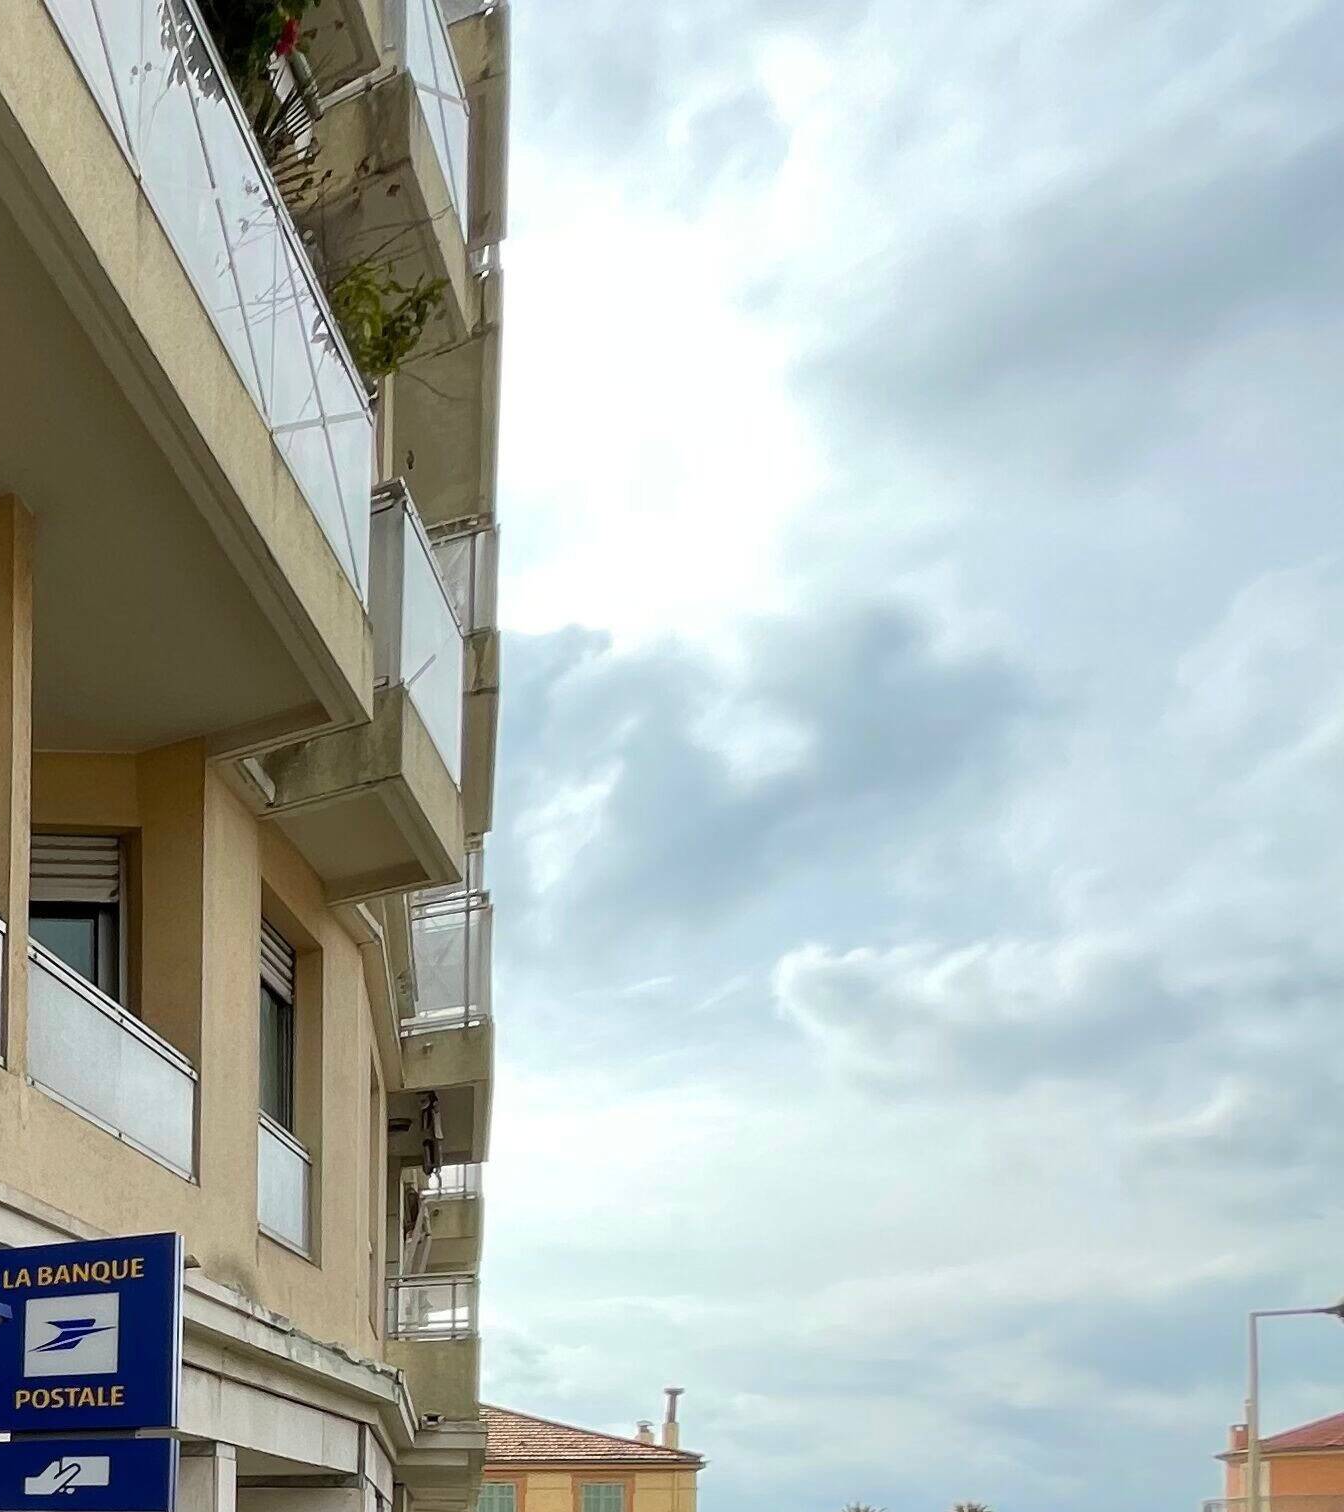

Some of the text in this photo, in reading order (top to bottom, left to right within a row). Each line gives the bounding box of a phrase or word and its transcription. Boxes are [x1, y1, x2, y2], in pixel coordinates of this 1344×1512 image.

[2, 1257, 145, 1289] LA BANQUE
[15, 1385, 125, 1410] POSTALE
